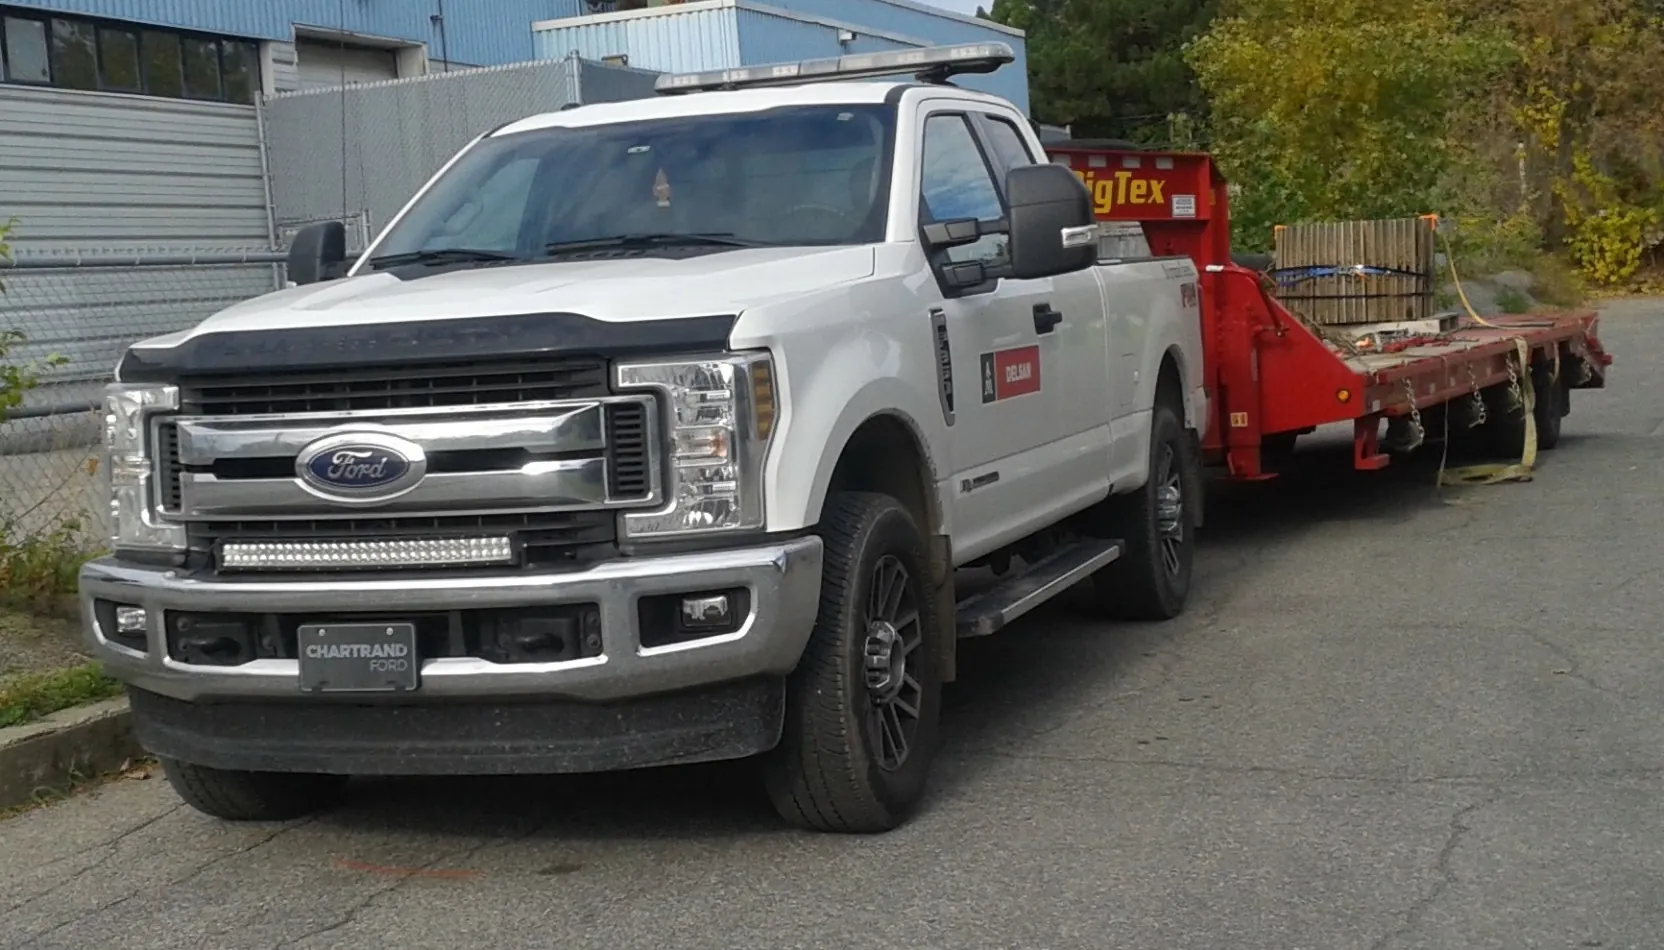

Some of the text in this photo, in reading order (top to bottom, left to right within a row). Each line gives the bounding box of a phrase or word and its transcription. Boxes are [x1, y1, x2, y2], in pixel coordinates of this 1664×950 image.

[327, 450, 388, 479] Ford
[306, 644, 408, 658] CHARTRAND
[370, 659, 408, 672] FORD
